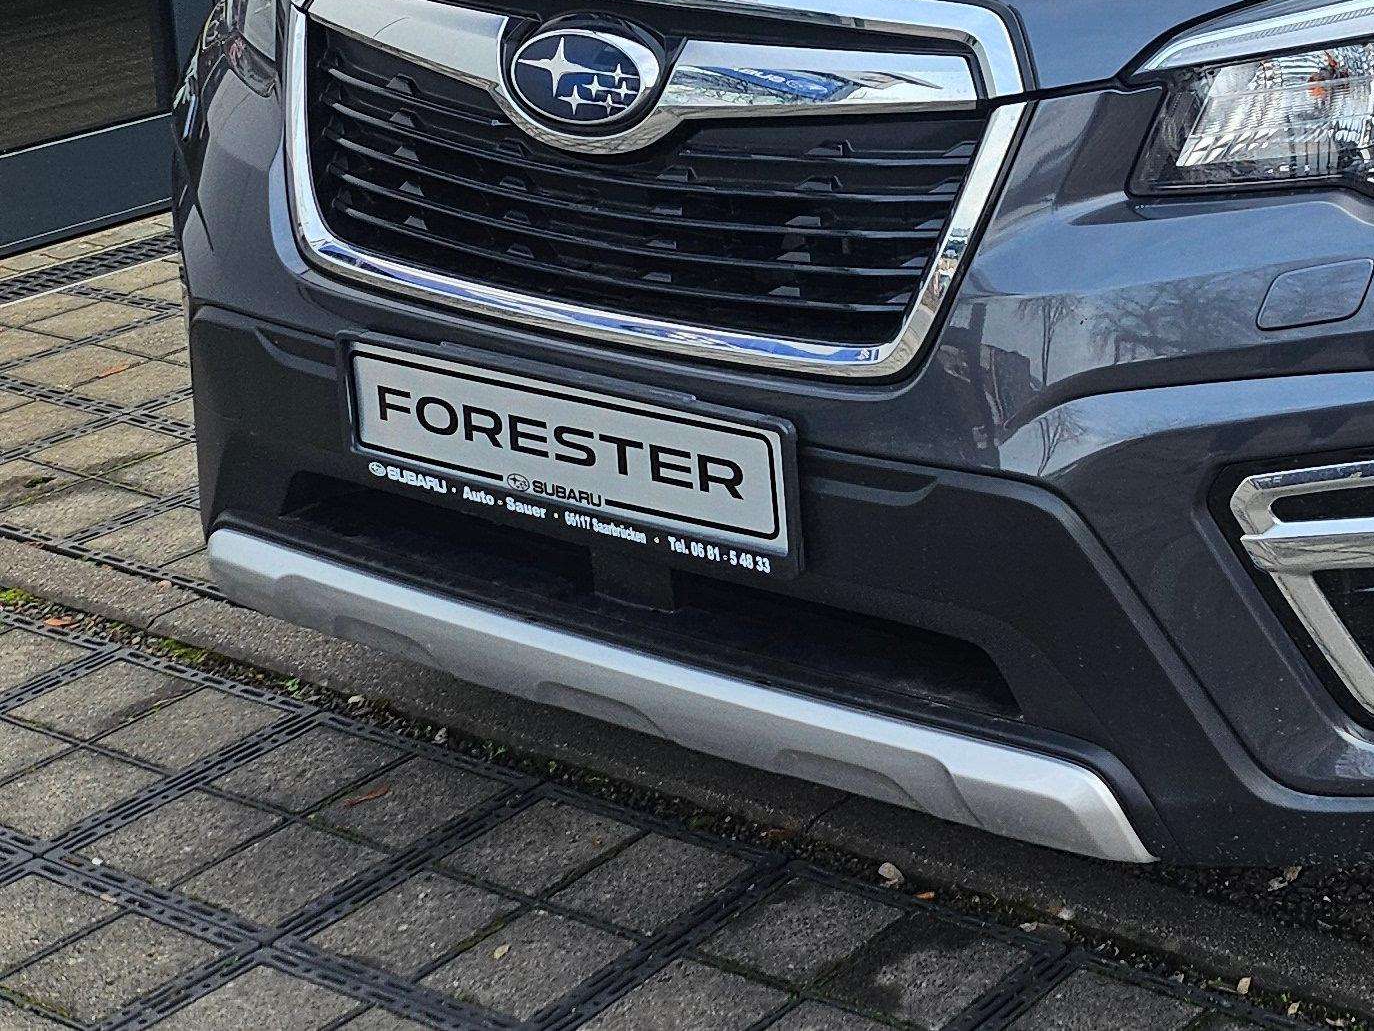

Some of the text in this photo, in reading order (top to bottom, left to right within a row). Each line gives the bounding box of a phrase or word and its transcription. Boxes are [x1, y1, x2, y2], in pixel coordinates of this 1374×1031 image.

[377, 384, 744, 500] FORESTER
[532, 479, 602, 508] SUBARU
[386, 465, 447, 494] SUBARU
[462, 485, 495, 505] Auto
[506, 496, 547, 519] Sauer
[592, 517, 647, 545] Saarbrücken
[667, 535, 690, 555] Tel.
[756, 555, 771, 574] 33
